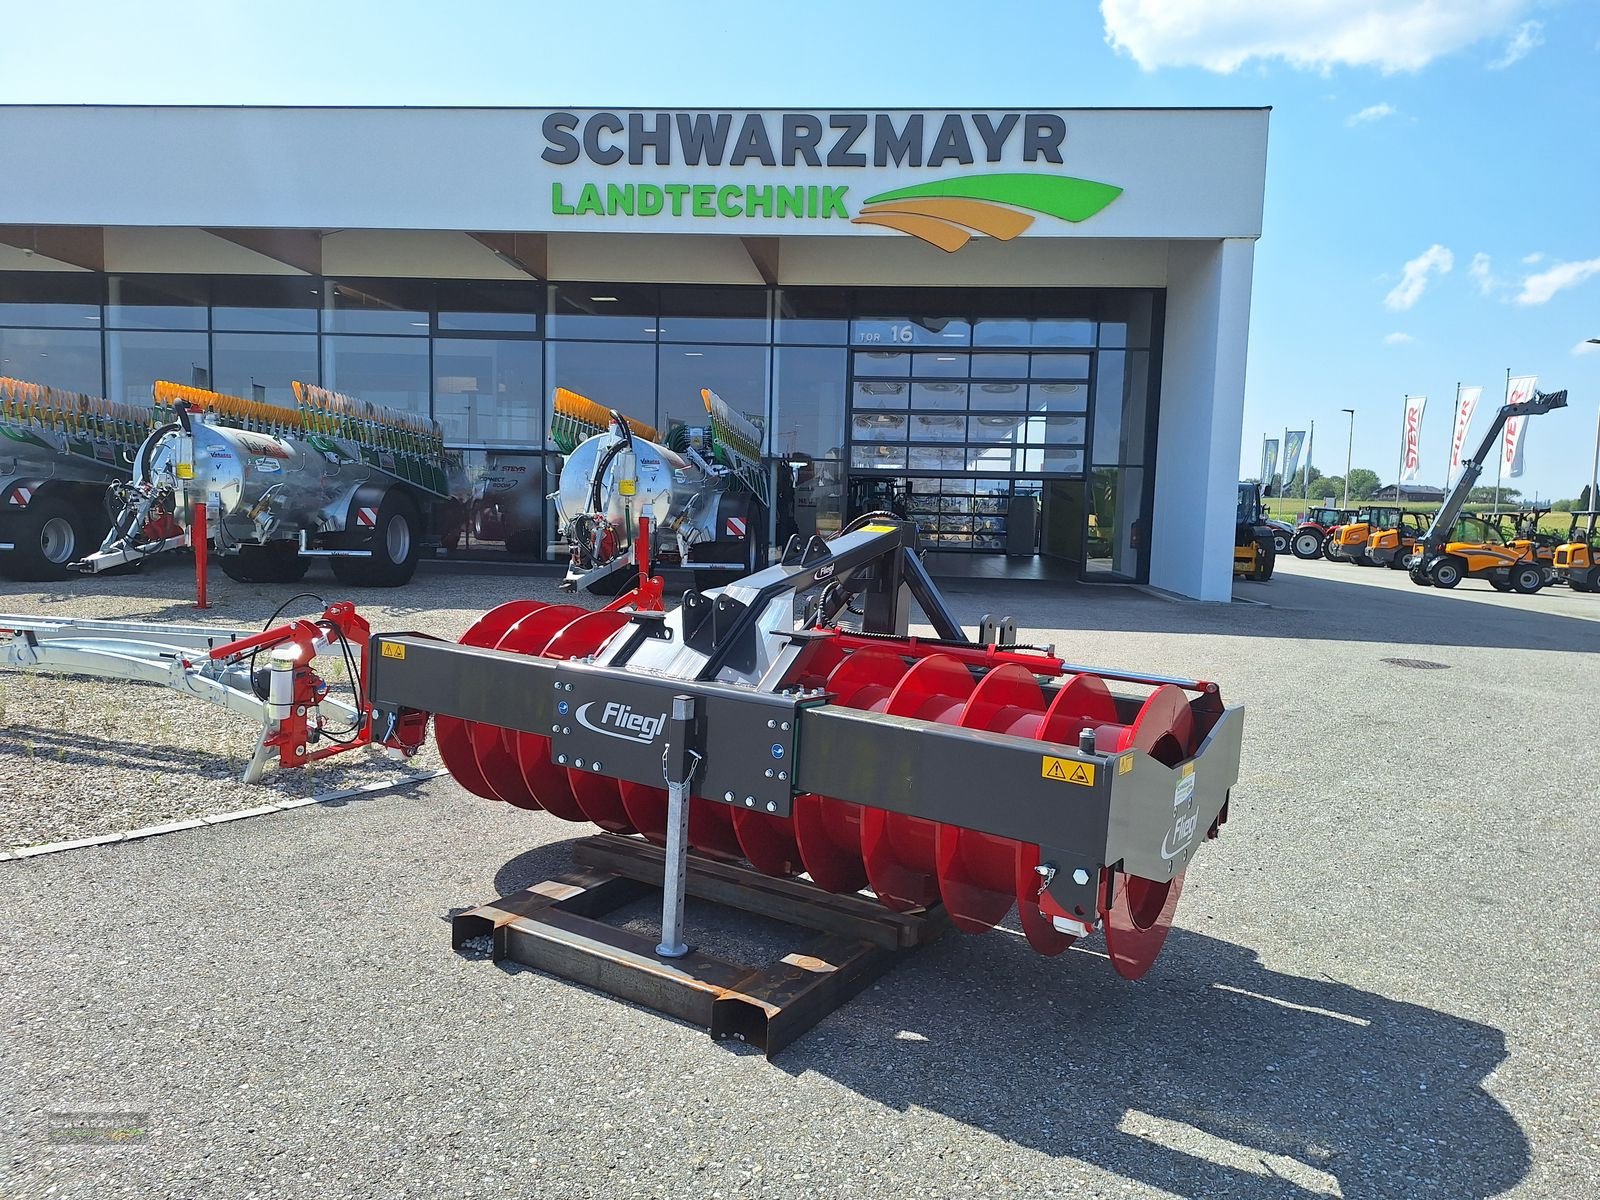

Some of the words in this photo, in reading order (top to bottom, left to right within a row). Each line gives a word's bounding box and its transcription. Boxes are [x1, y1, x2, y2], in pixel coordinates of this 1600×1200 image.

[541, 112, 1066, 168] SCHWARZMAYR
[552, 183, 849, 218] LANDTECHNIK
[860, 333, 880, 342] TOR
[891, 325, 913, 342] 16
[1405, 407, 1418, 469] STEYR
[1506, 390, 1524, 463] STER
[502, 465, 526, 473] STEYR
[601, 702, 667, 740] Fliegl
[1172, 805, 1199, 846] Fliegl
